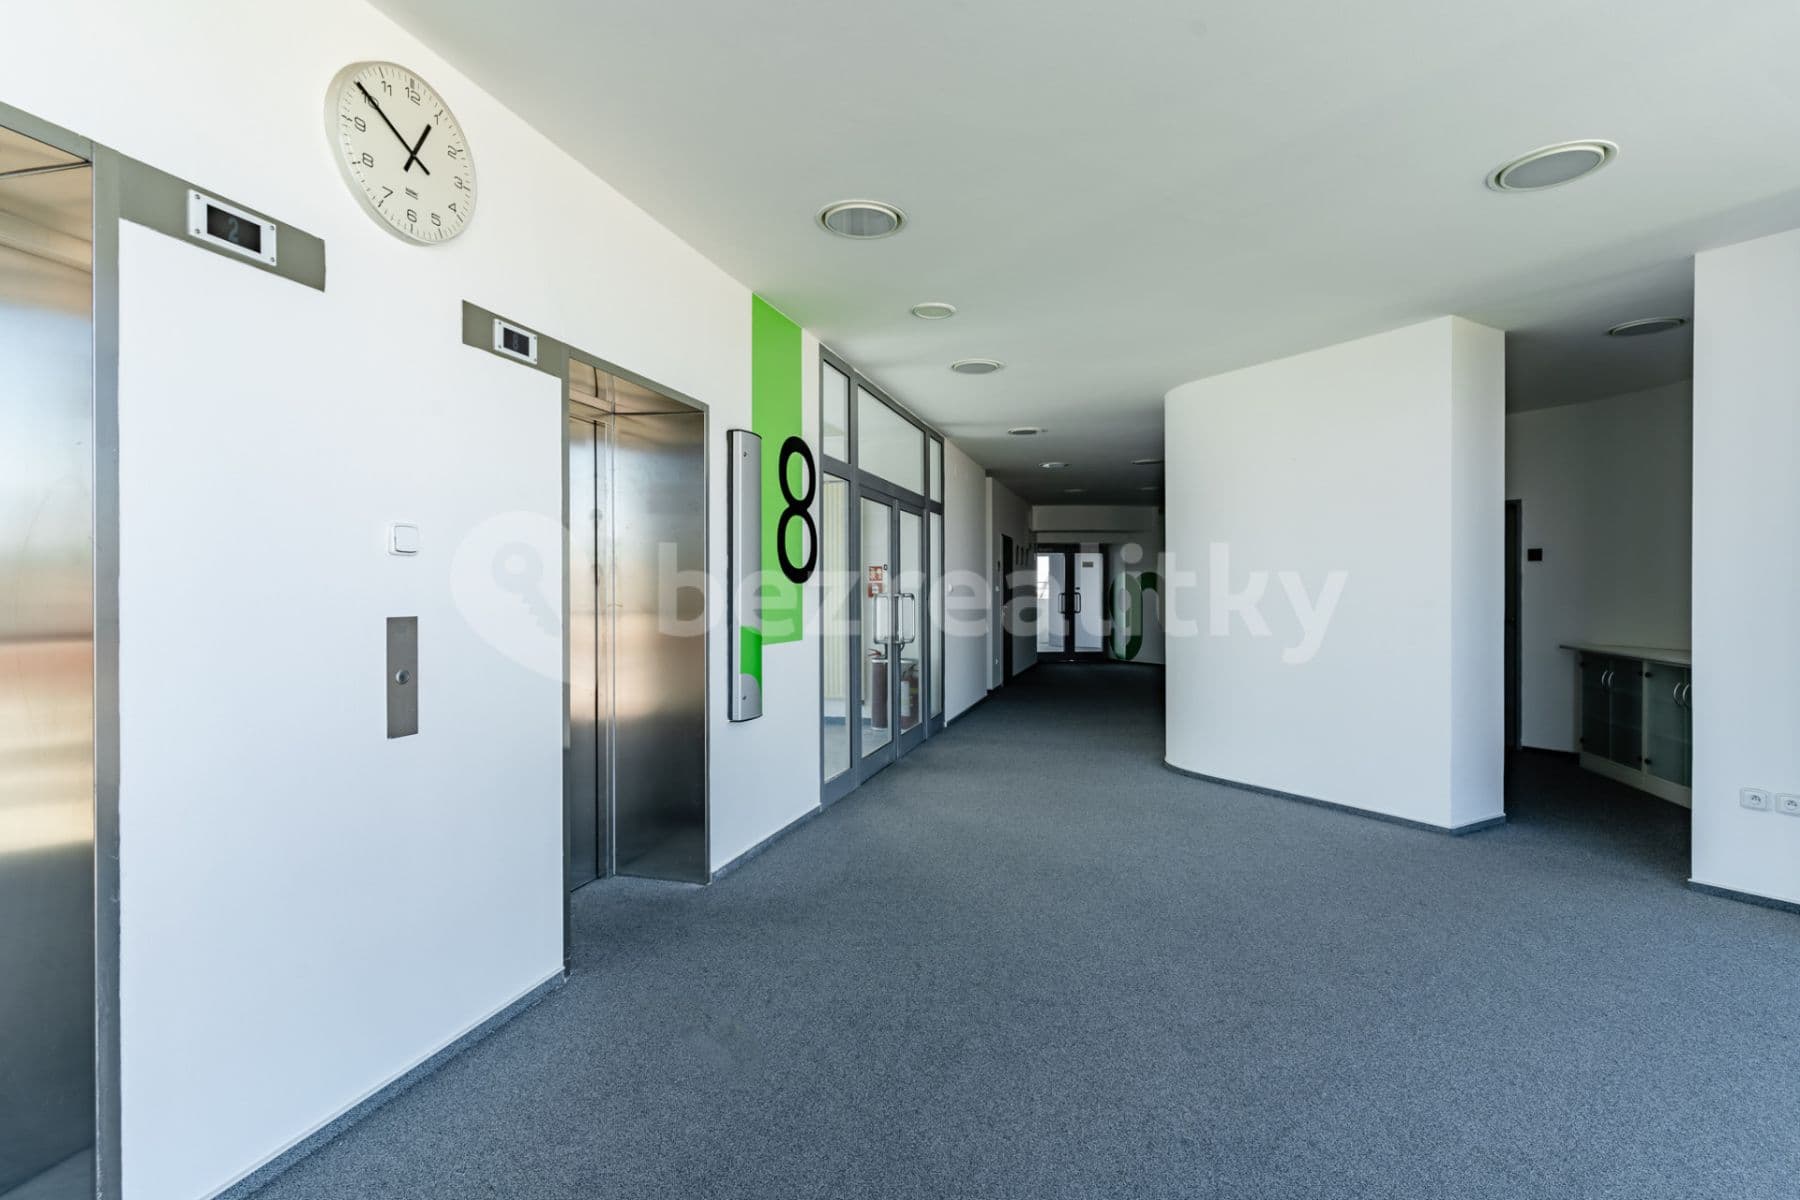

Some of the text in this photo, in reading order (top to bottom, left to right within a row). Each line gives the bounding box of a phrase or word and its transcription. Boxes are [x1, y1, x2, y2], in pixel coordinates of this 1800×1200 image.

[381, 80, 392, 97] 11
[404, 86, 421, 106] 12
[353, 116, 366, 132] 9
[433, 114, 439, 126] 1
[447, 144, 457, 159] 2
[362, 152, 374, 168] 8
[453, 175, 463, 190] 3
[381, 185, 394, 199] 7
[447, 202, 457, 213] 4
[406, 208, 418, 223] 6
[430, 212, 441, 227] 5
[227, 216, 241, 244] 2
[777, 436, 818, 584] 8
